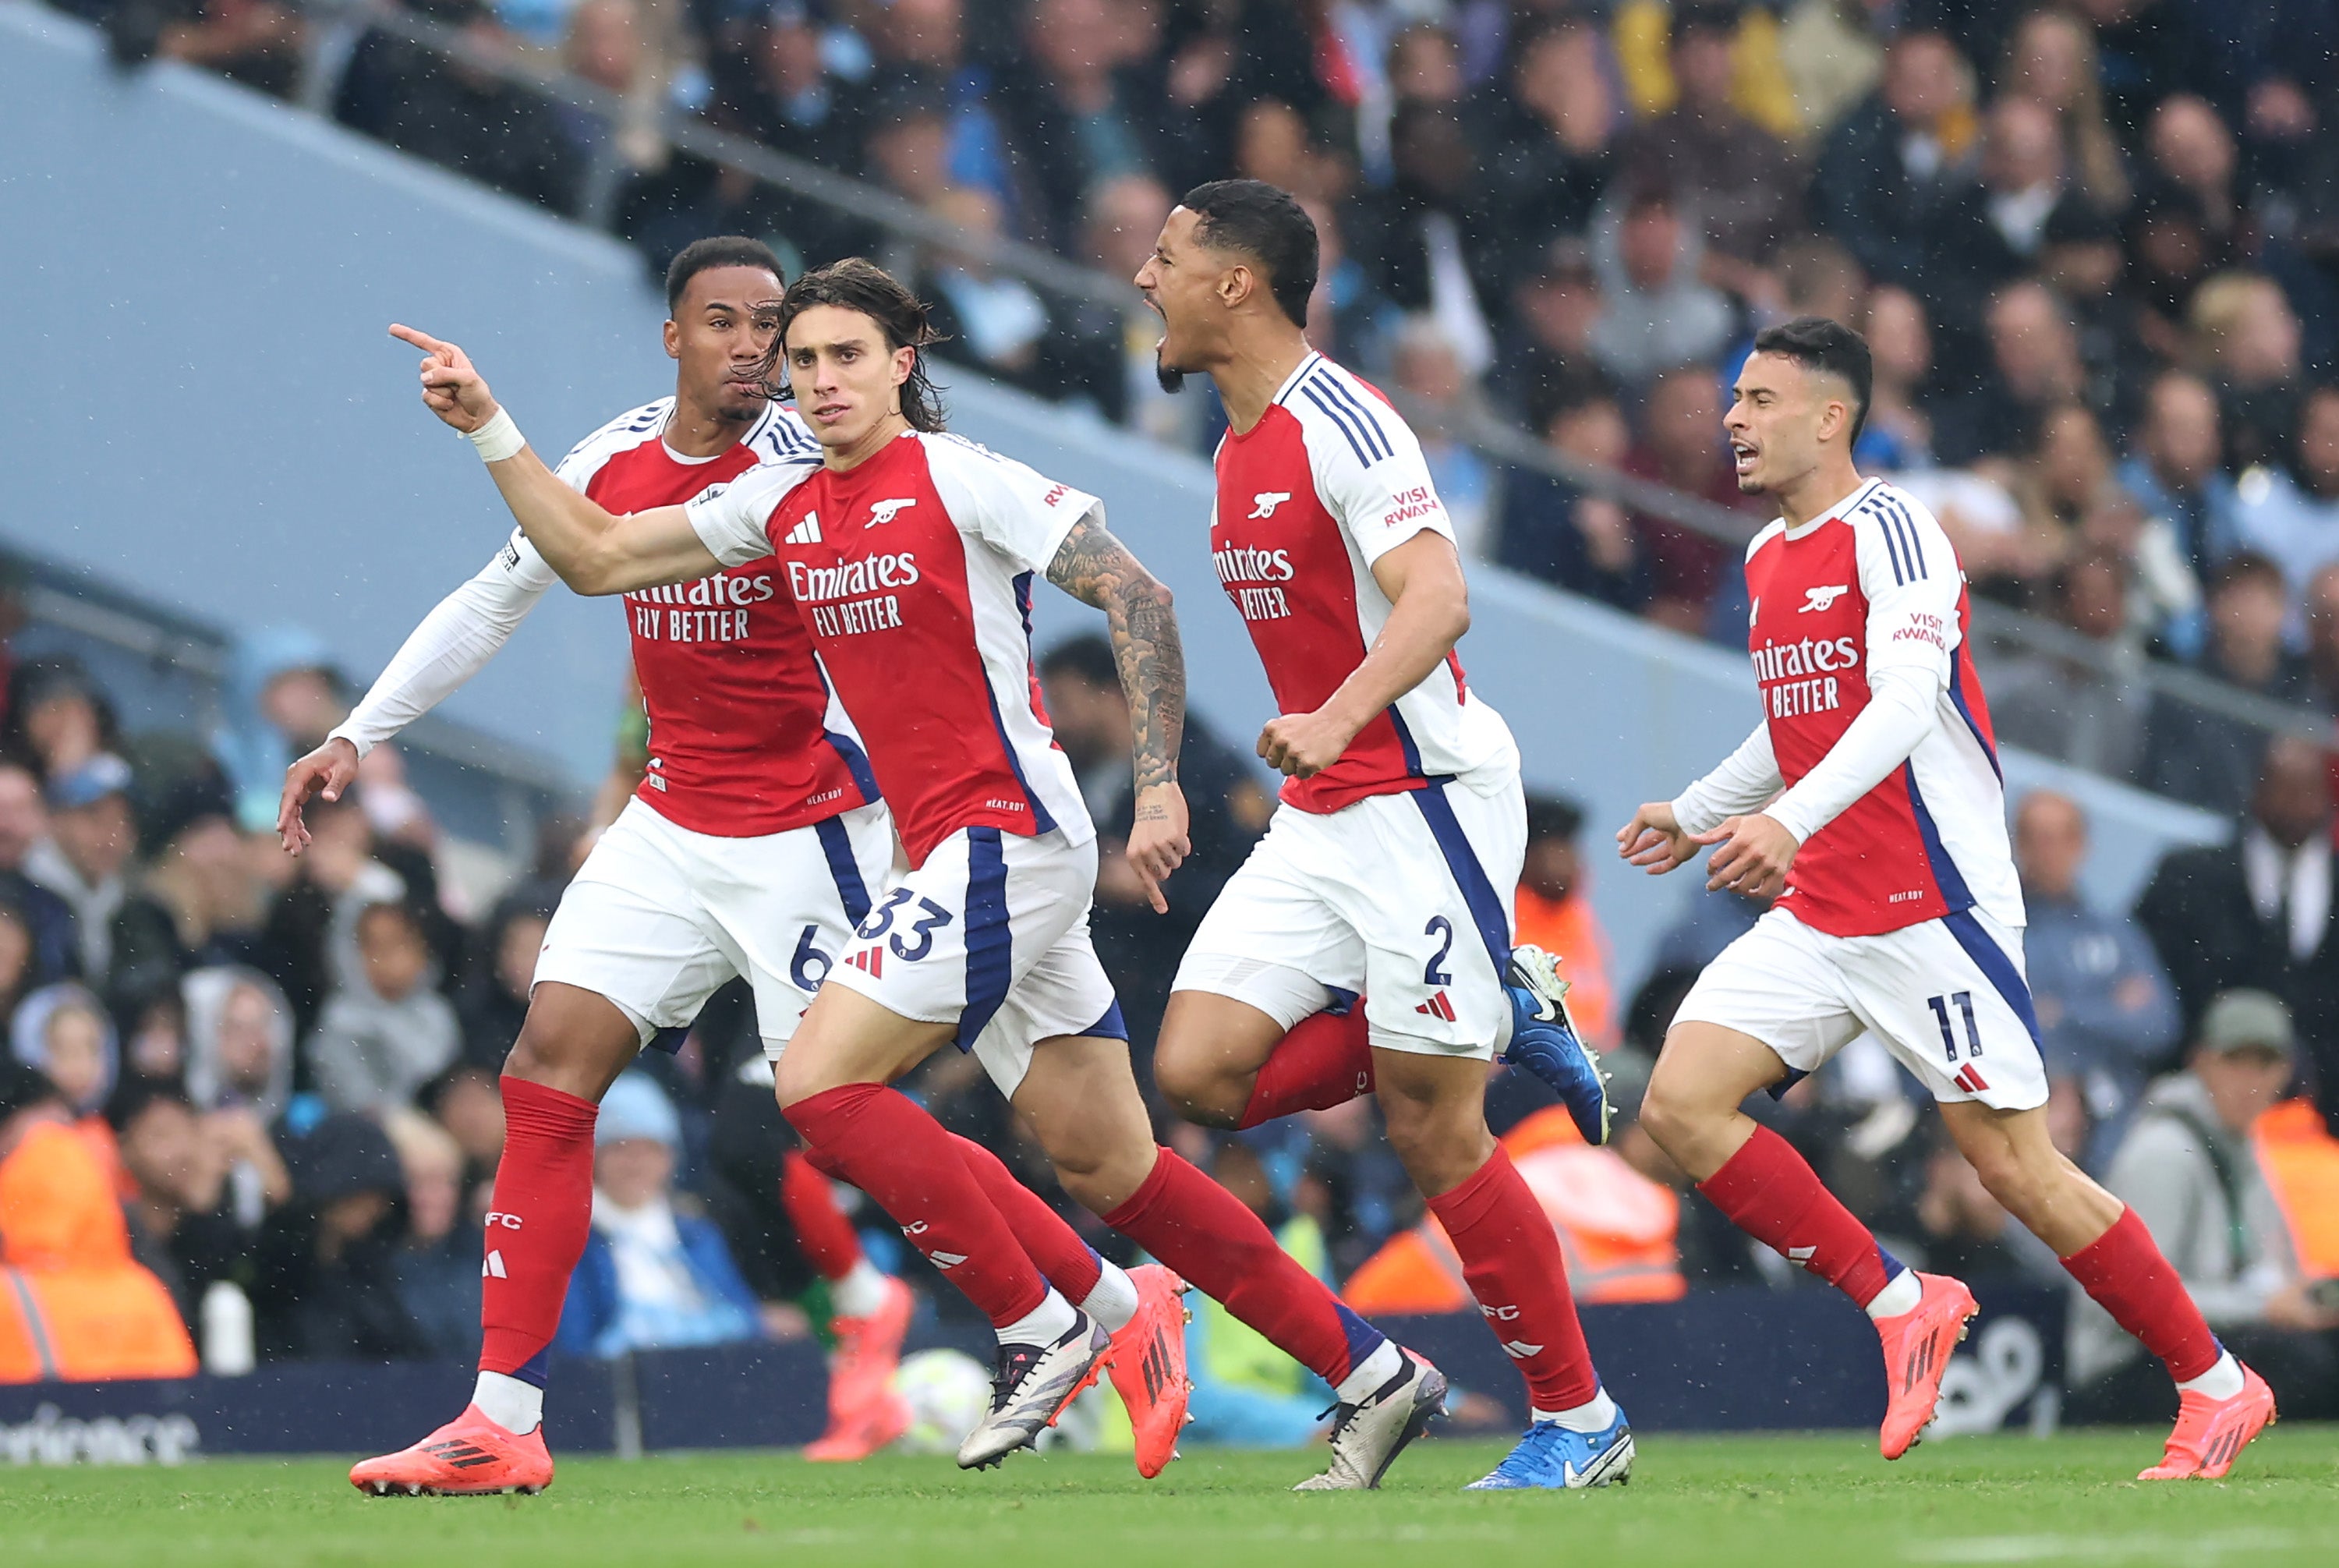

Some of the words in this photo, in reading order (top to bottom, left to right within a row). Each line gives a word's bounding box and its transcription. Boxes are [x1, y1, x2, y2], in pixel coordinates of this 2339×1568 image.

[787, 551, 919, 602] Emirates
[635, 606, 661, 641] FLY
[669, 608, 749, 642] BETTER
[812, 605, 841, 638] FLY
[840, 595, 903, 635] BETTER
[1771, 676, 1840, 720] BETTER
[857, 887, 954, 962] 33
[790, 925, 833, 992] 6
[1424, 915, 1453, 986] 2
[1927, 990, 1983, 1062] 11
[485, 1211, 523, 1230] FC
